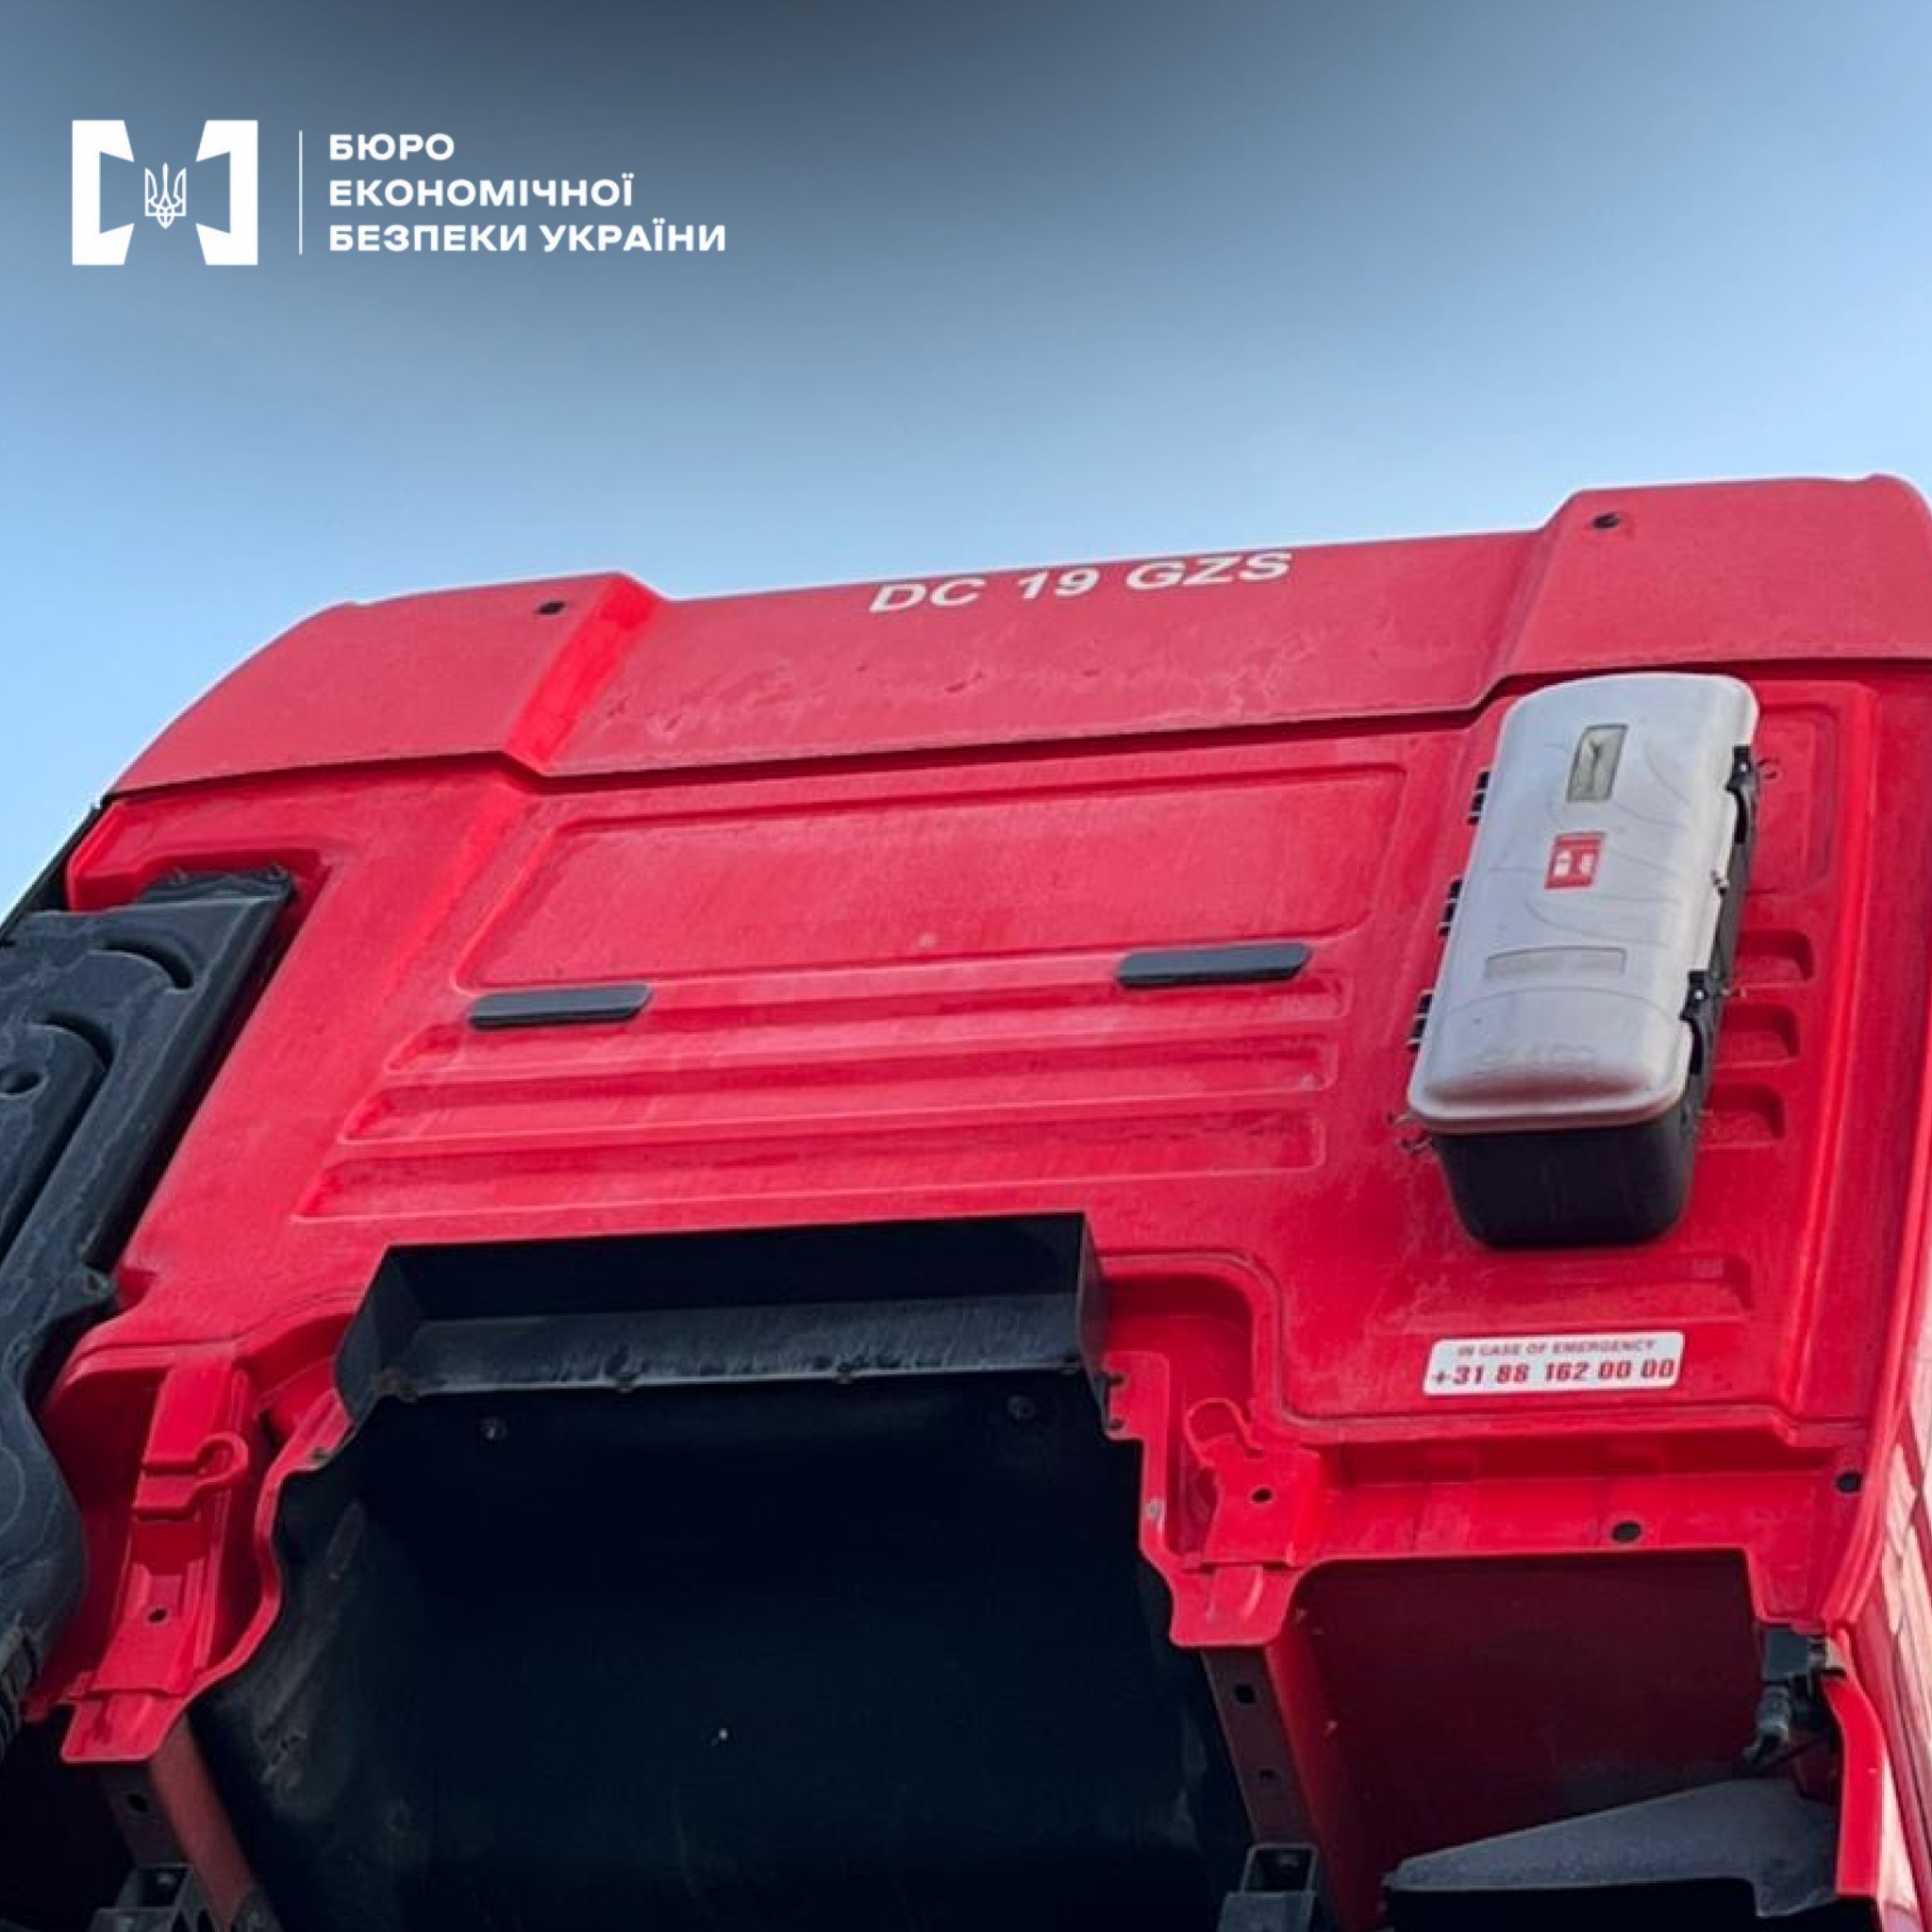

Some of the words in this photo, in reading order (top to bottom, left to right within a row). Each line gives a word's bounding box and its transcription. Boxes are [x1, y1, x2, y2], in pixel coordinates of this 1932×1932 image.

[869, 577, 986, 613] DC
[1019, 566, 1100, 600] 19
[1125, 551, 1291, 591] GZS
[1478, 1342, 1521, 1357] CASE
[1525, 1341, 1547, 1356] OF
[1552, 1339, 1657, 1355] EMERGENCY
[1431, 1364, 1484, 1385] +31
[1544, 1359, 1590, 1382] 162
[1598, 1358, 1632, 1380] 00
[1640, 1357, 1676, 1379] 00
